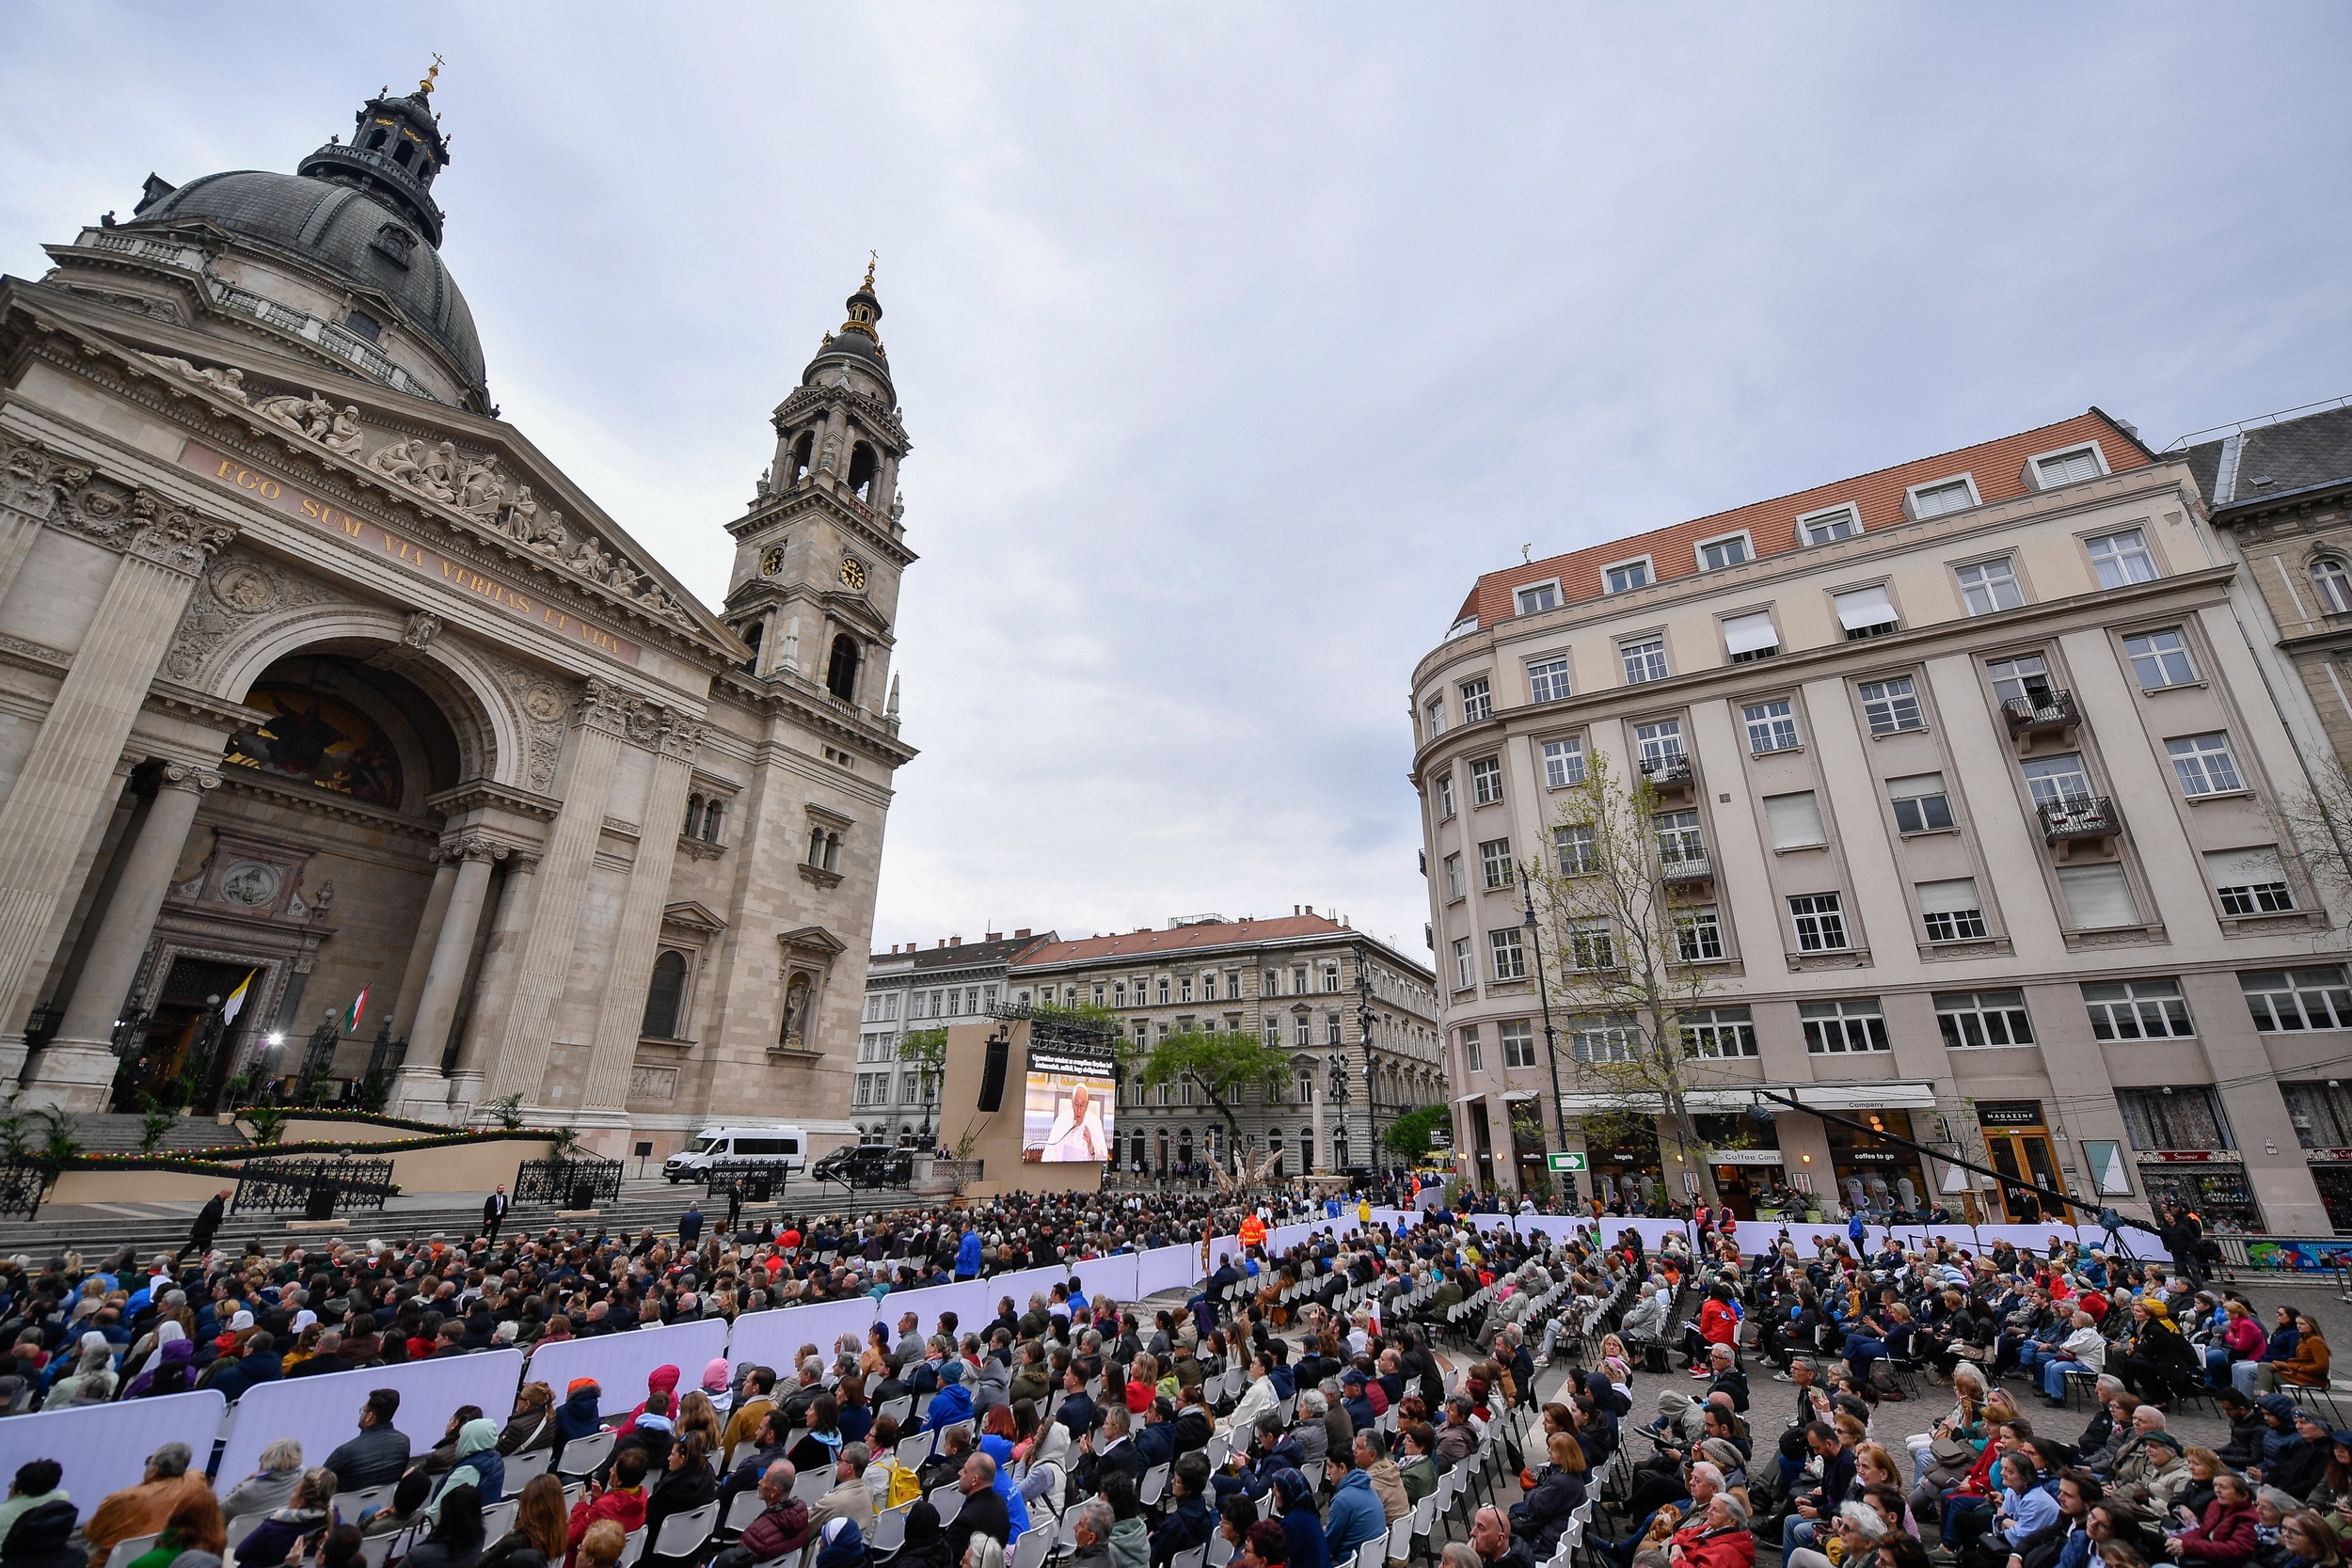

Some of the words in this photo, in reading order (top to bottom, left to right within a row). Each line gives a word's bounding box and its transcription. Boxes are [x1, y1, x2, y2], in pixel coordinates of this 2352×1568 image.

[215, 459, 280, 500] EGO
[299, 499, 363, 539] SUM
[383, 533, 422, 567] VIA
[441, 562, 531, 613] VERITAS
[544, 609, 569, 630] ET
[580, 624, 618, 654] VITA
